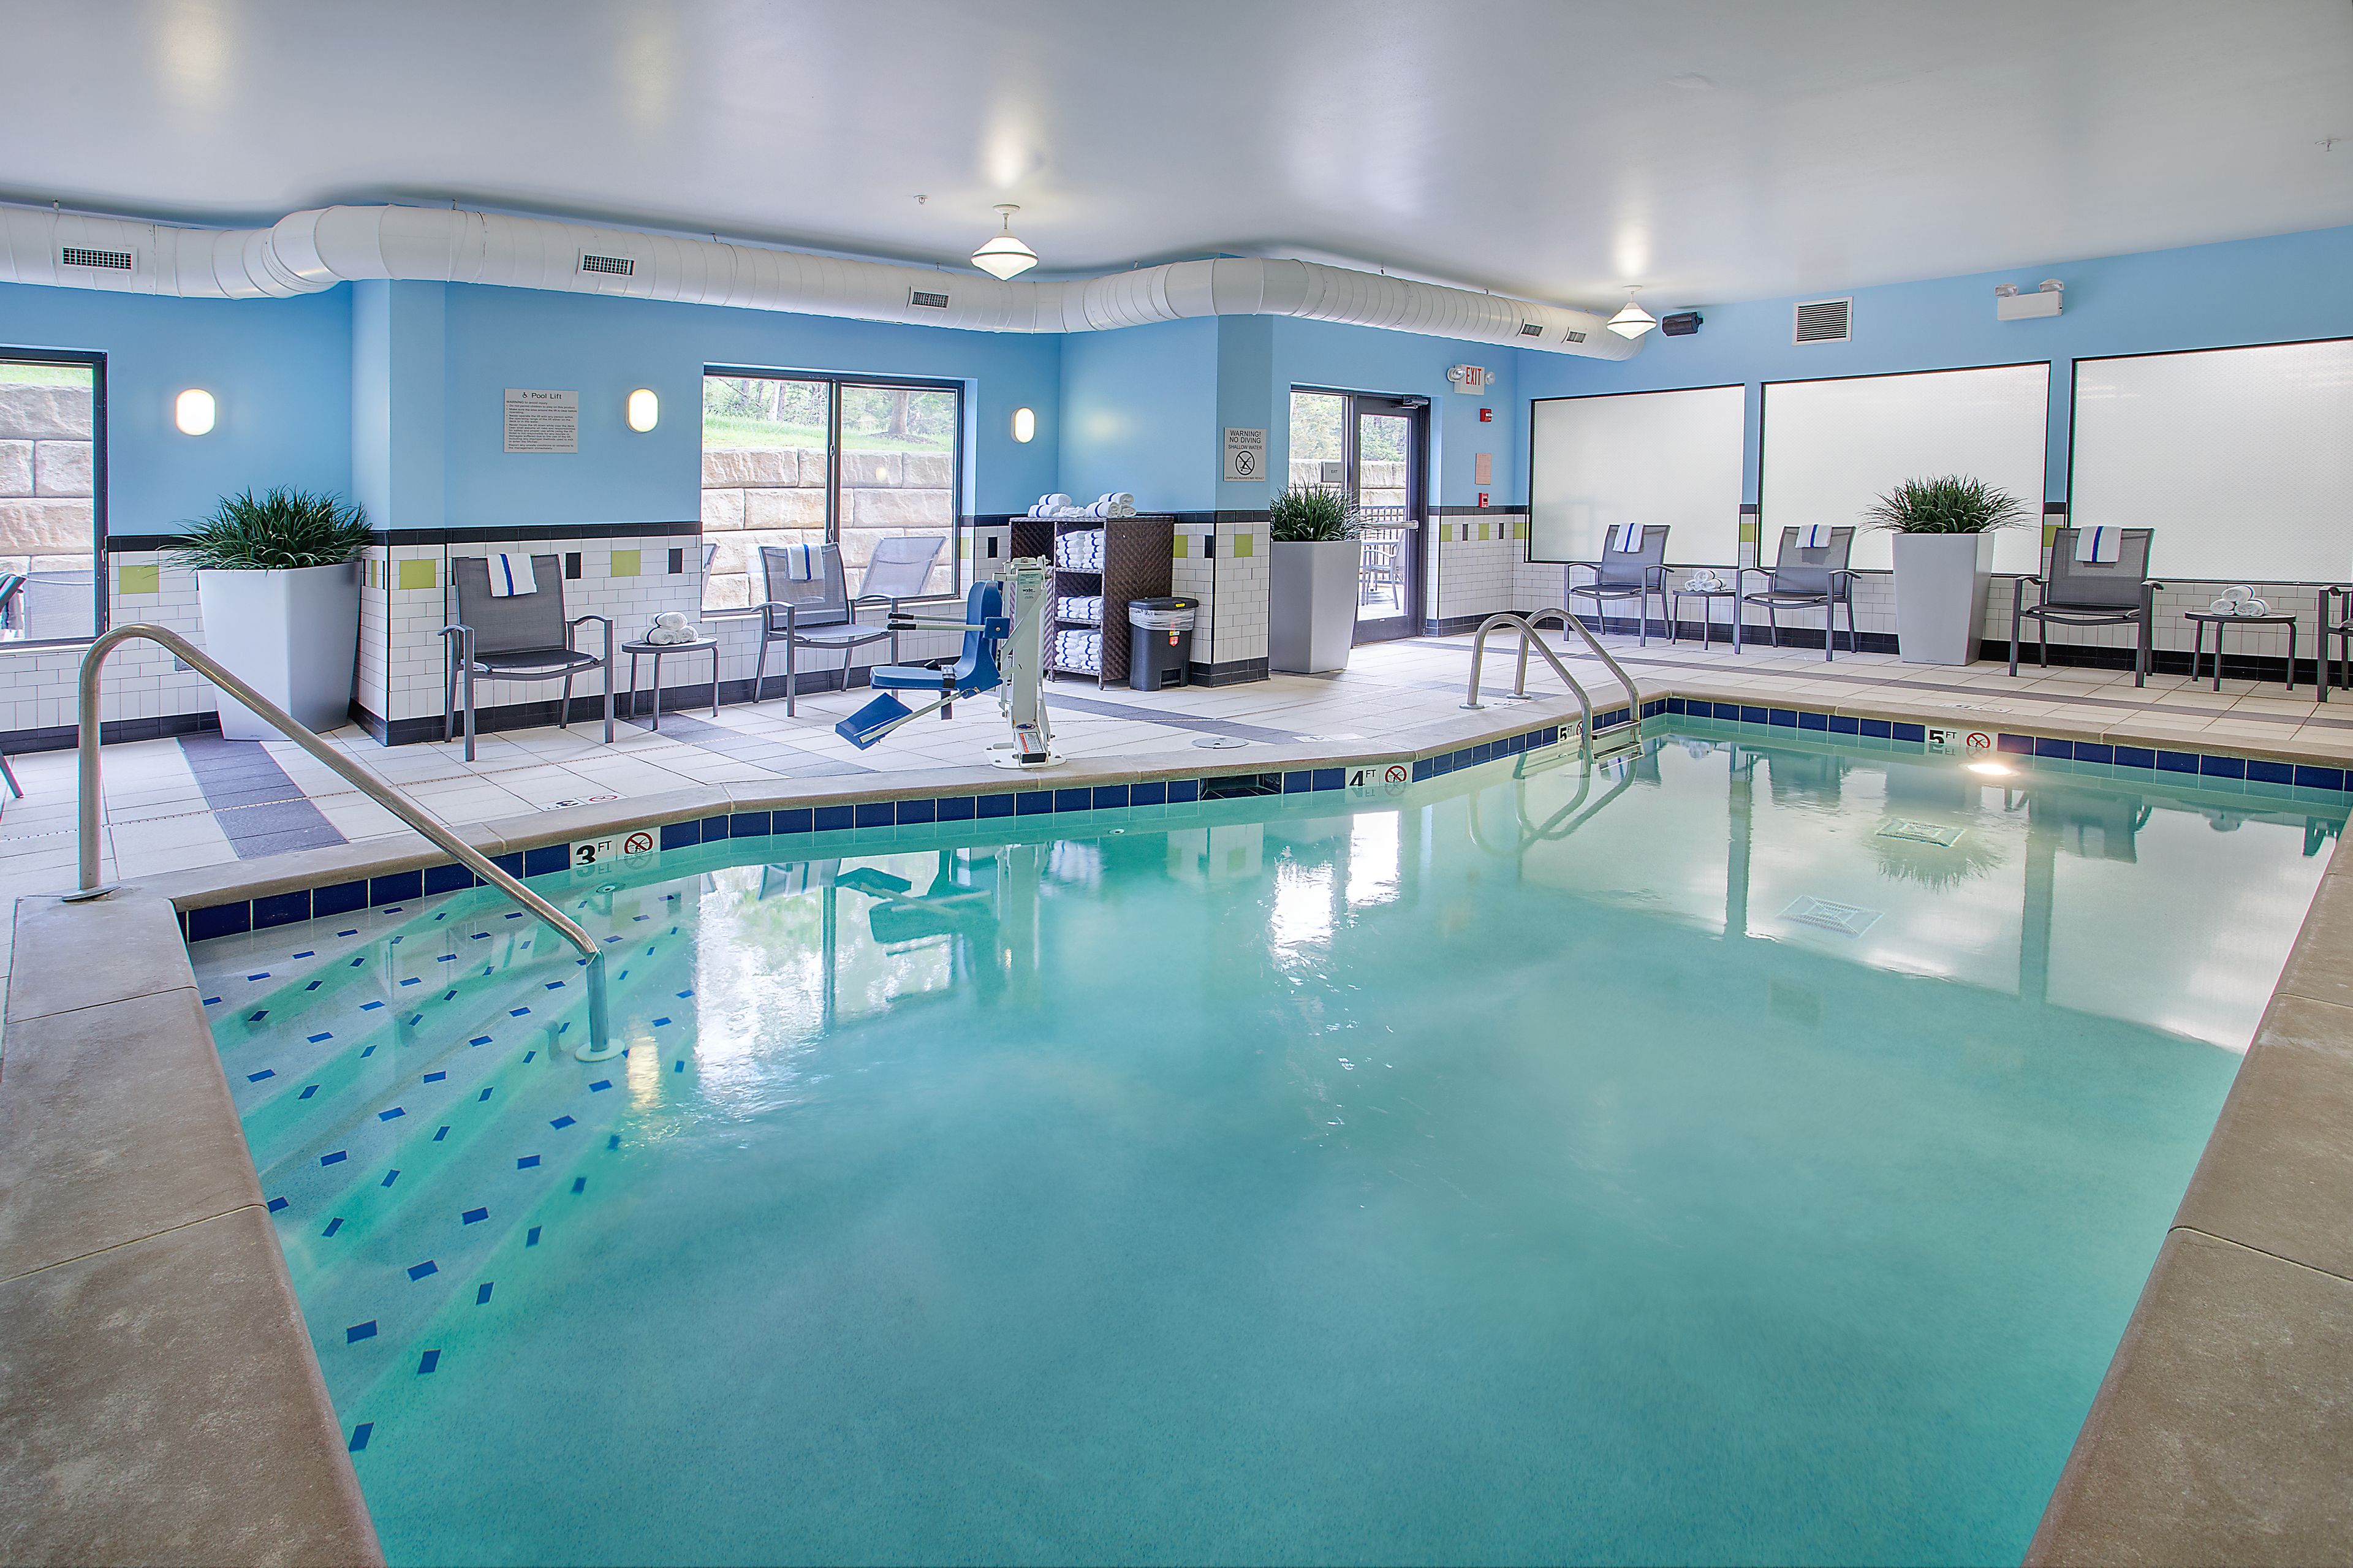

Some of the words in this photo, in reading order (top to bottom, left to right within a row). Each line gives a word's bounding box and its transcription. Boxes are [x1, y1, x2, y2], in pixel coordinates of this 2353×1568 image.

[1466, 366, 1482, 386] EXIT
[1560, 727, 1567, 741] 5
[1929, 730, 1944, 744] 5
[1349, 770, 1365, 786] 4
[1366, 770, 1376, 778] FT
[576, 844, 596, 866] 3
[597, 840, 612, 852] FT
